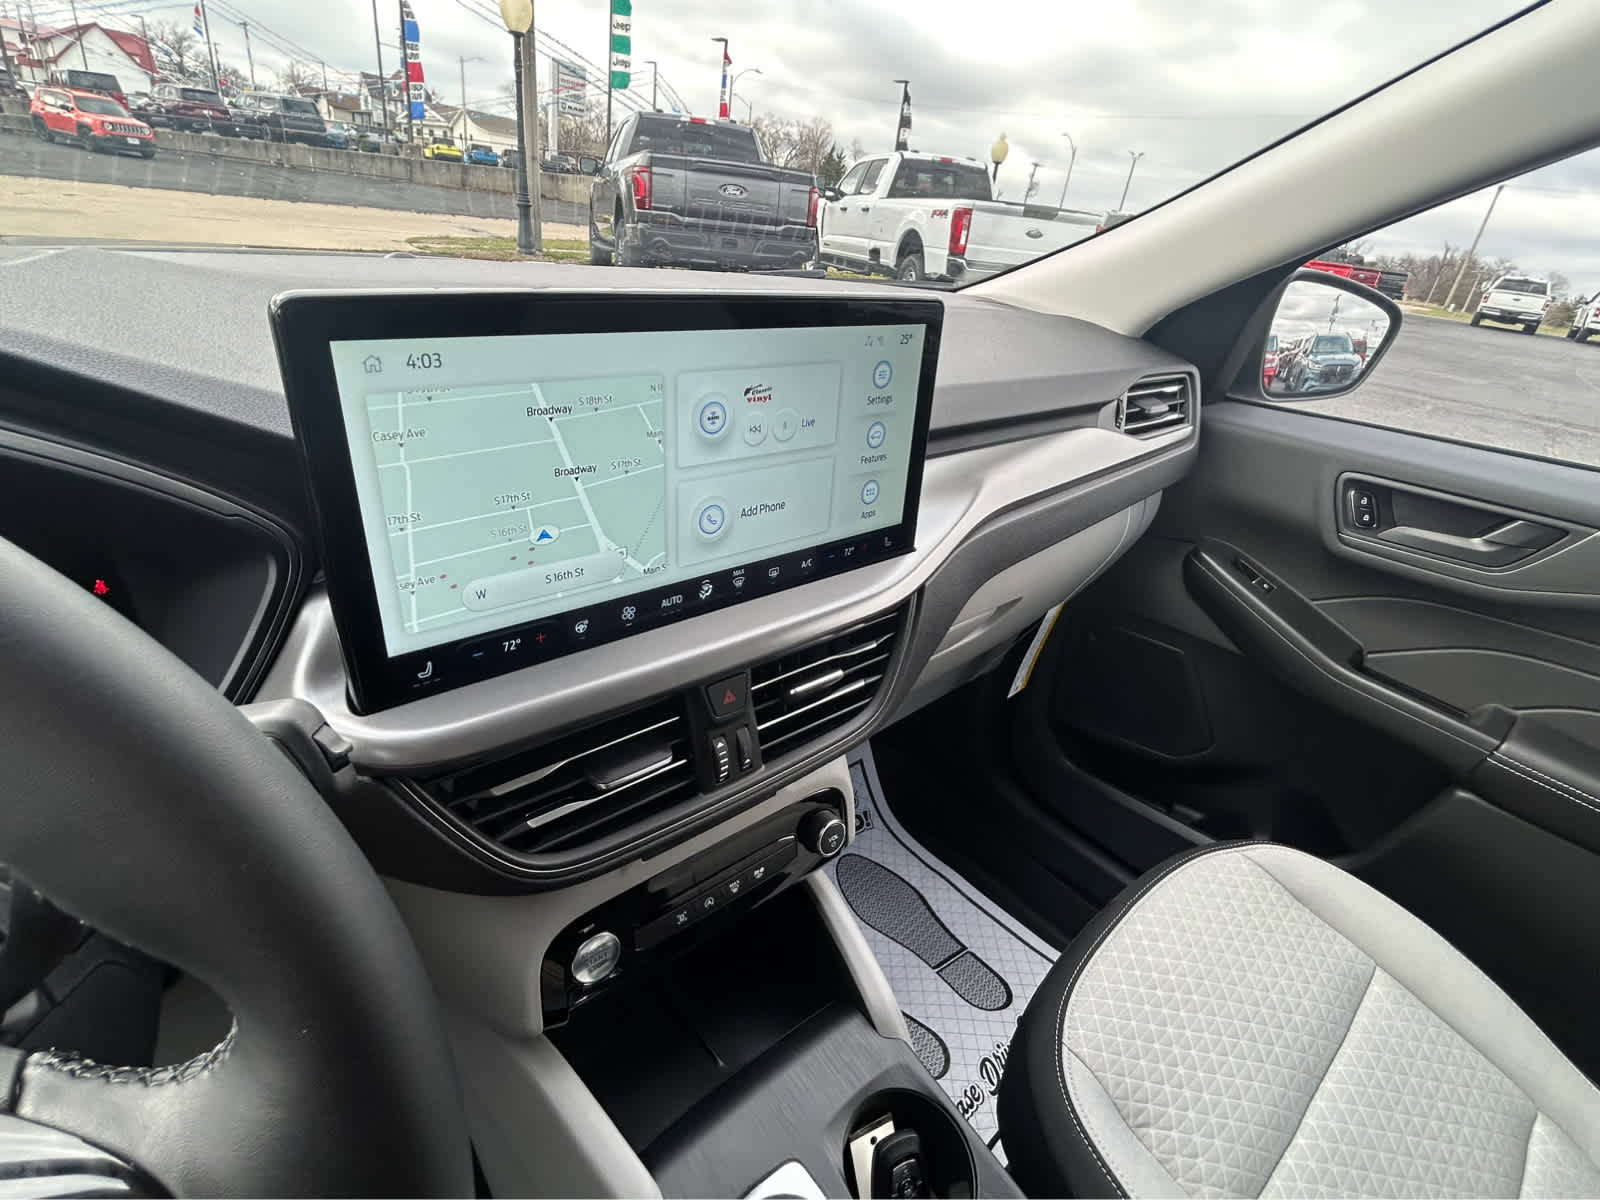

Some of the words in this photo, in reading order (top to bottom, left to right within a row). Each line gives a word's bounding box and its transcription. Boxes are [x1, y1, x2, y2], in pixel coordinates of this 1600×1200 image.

[612, 19, 631, 33] Jeep
[406, 352, 443, 369] 4:03
[578, 396, 585, 406] S
[585, 395, 603, 405] 18th
[604, 394, 613, 403] St
[746, 394, 772, 403] vinyl
[866, 393, 893, 406] Settings
[526, 404, 573, 417] Broadway
[801, 417, 816, 429] Live
[372, 429, 404, 442] Casey
[406, 428, 426, 439] Ave
[610, 461, 617, 471] S
[617, 460, 633, 469] 17th
[633, 458, 642, 466] St
[860, 452, 888, 465] Features
[554, 464, 598, 478] Broadway
[494, 496, 500, 505] S
[500, 494, 520, 504] 17th
[520, 491, 531, 501] St
[740, 504, 758, 519] Add
[759, 500, 786, 514] Phone
[860, 509, 876, 520] Apps
[386, 515, 409, 526] 17th
[409, 511, 422, 523] St
[800, 558, 813, 569] A/C
[545, 574, 552, 584] S
[553, 570, 573, 582] 16th
[574, 567, 585, 577] St
[732, 568, 745, 577] MAX
[416, 576, 436, 586] Ave
[475, 589, 488, 601] W
[661, 595, 683, 608] AUTO
